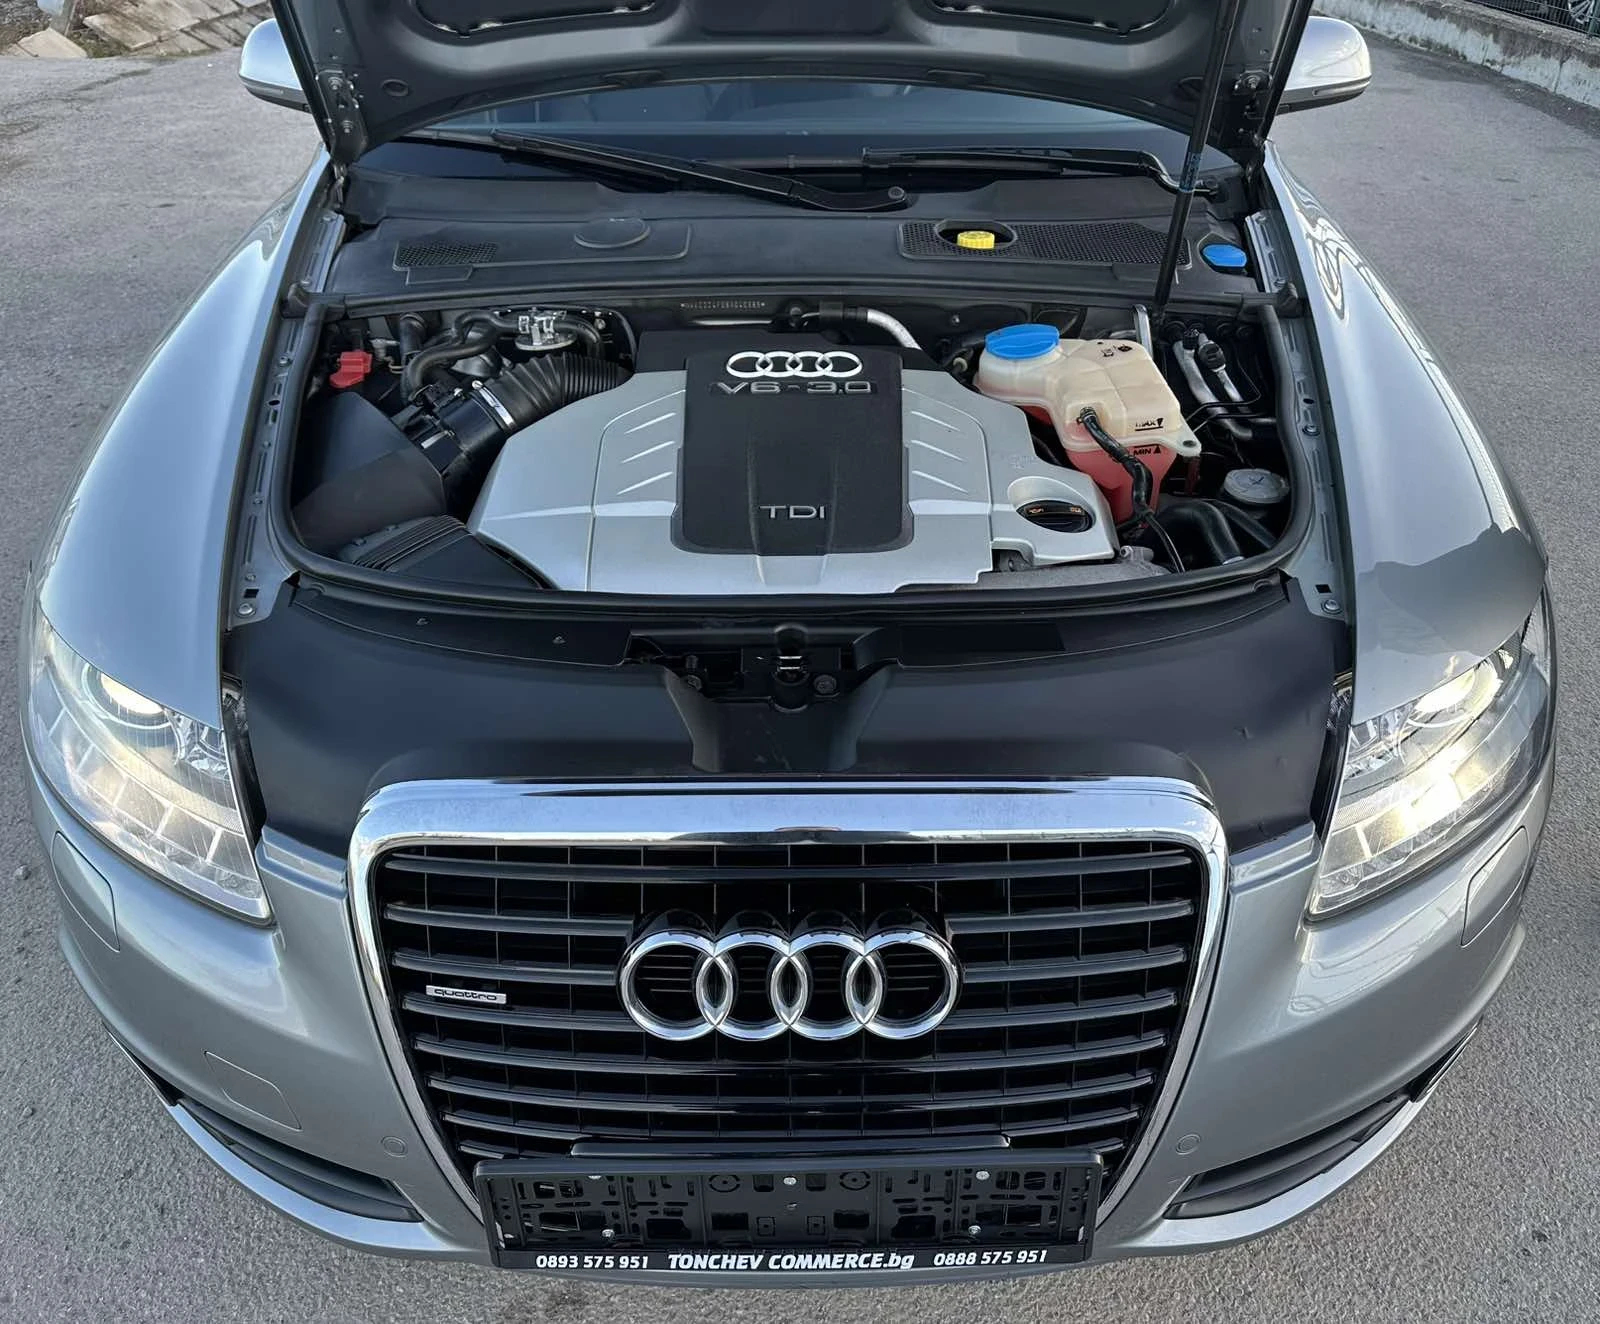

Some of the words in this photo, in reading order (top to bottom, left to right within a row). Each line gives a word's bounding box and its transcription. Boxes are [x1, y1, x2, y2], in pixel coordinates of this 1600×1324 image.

[759, 505, 826, 519] TDI
[433, 988, 498, 1001] quattro
[535, 1255, 579, 1269] 0893
[583, 1255, 615, 1269] 575
[618, 1255, 649, 1269] 951
[668, 1253, 765, 1270] TONCHEV
[768, 1252, 915, 1270] COMMERCE.bg
[933, 1251, 978, 1266] 0888
[980, 1251, 1013, 1265] 575
[1016, 1249, 1048, 1264] 951
